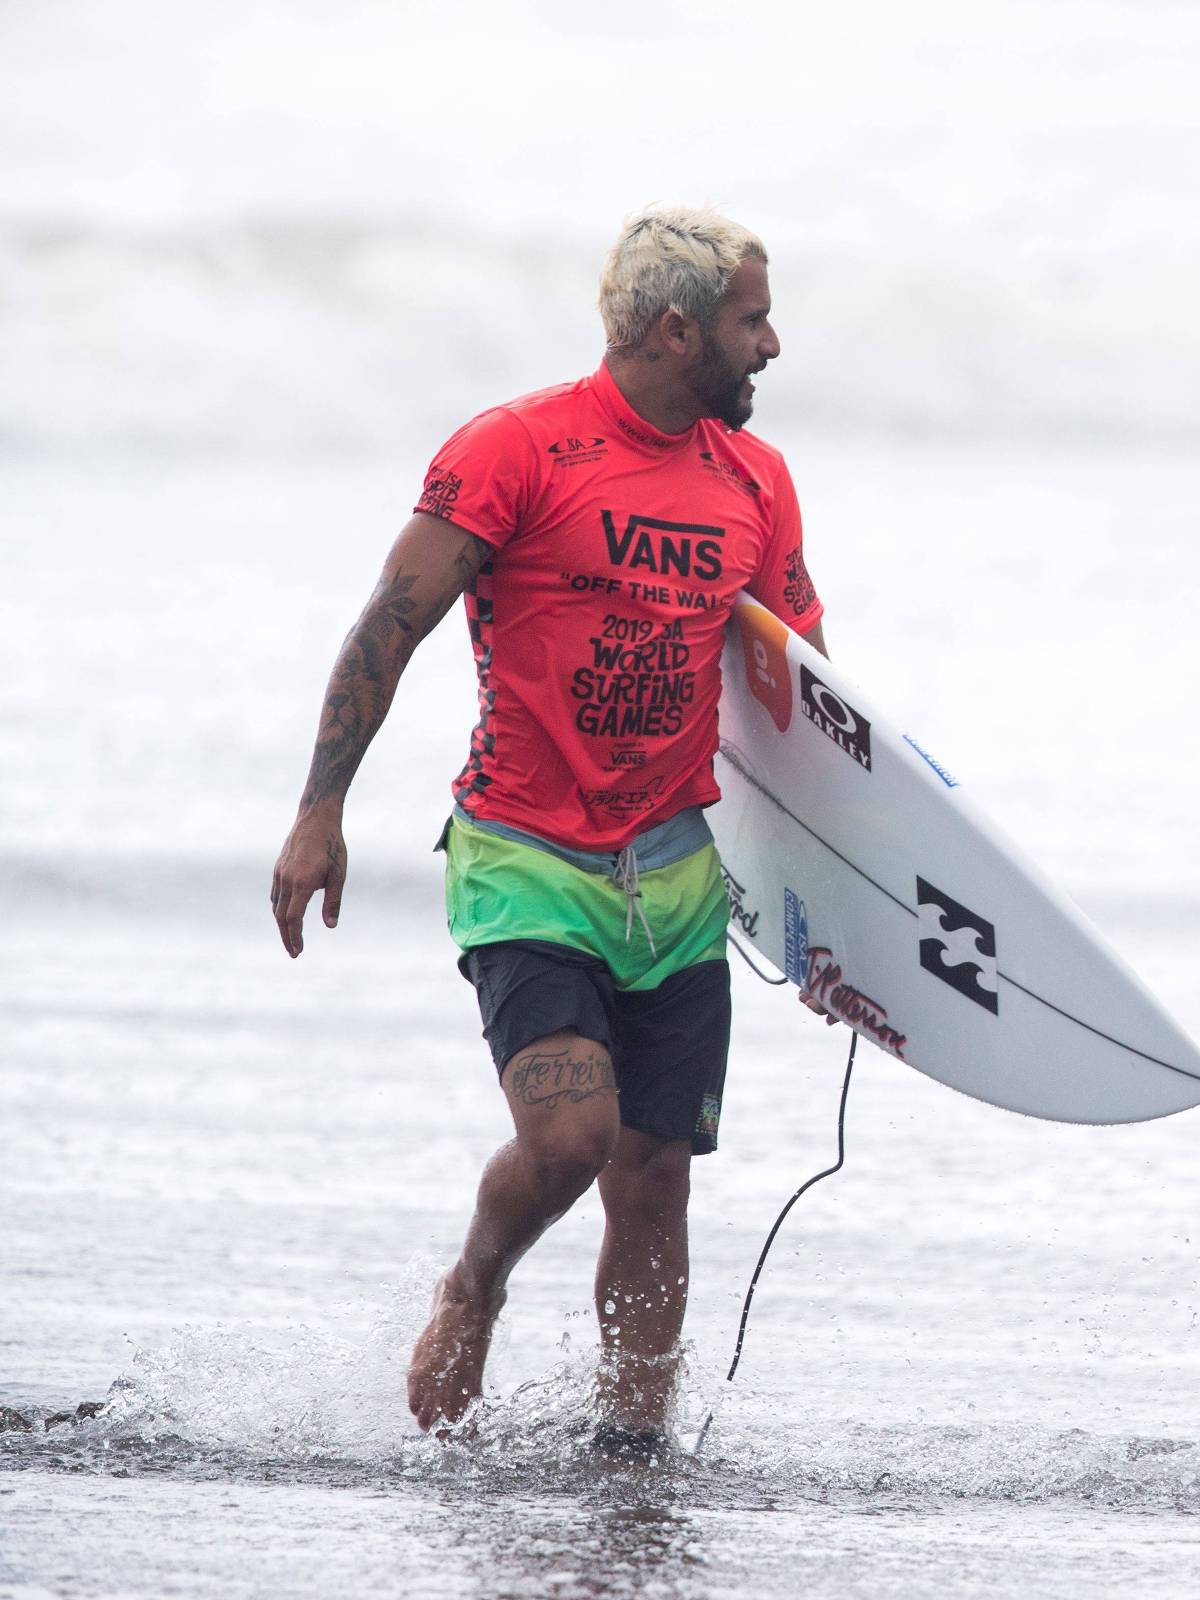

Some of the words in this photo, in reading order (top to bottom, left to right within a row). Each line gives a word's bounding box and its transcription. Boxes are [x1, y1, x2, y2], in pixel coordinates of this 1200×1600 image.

[601, 509, 725, 581] VANS
[629, 582, 670, 605] THE
[601, 614, 653, 644] 2019
[576, 702, 684, 737] GAMES
[801, 699, 870, 768] OAKLEY
